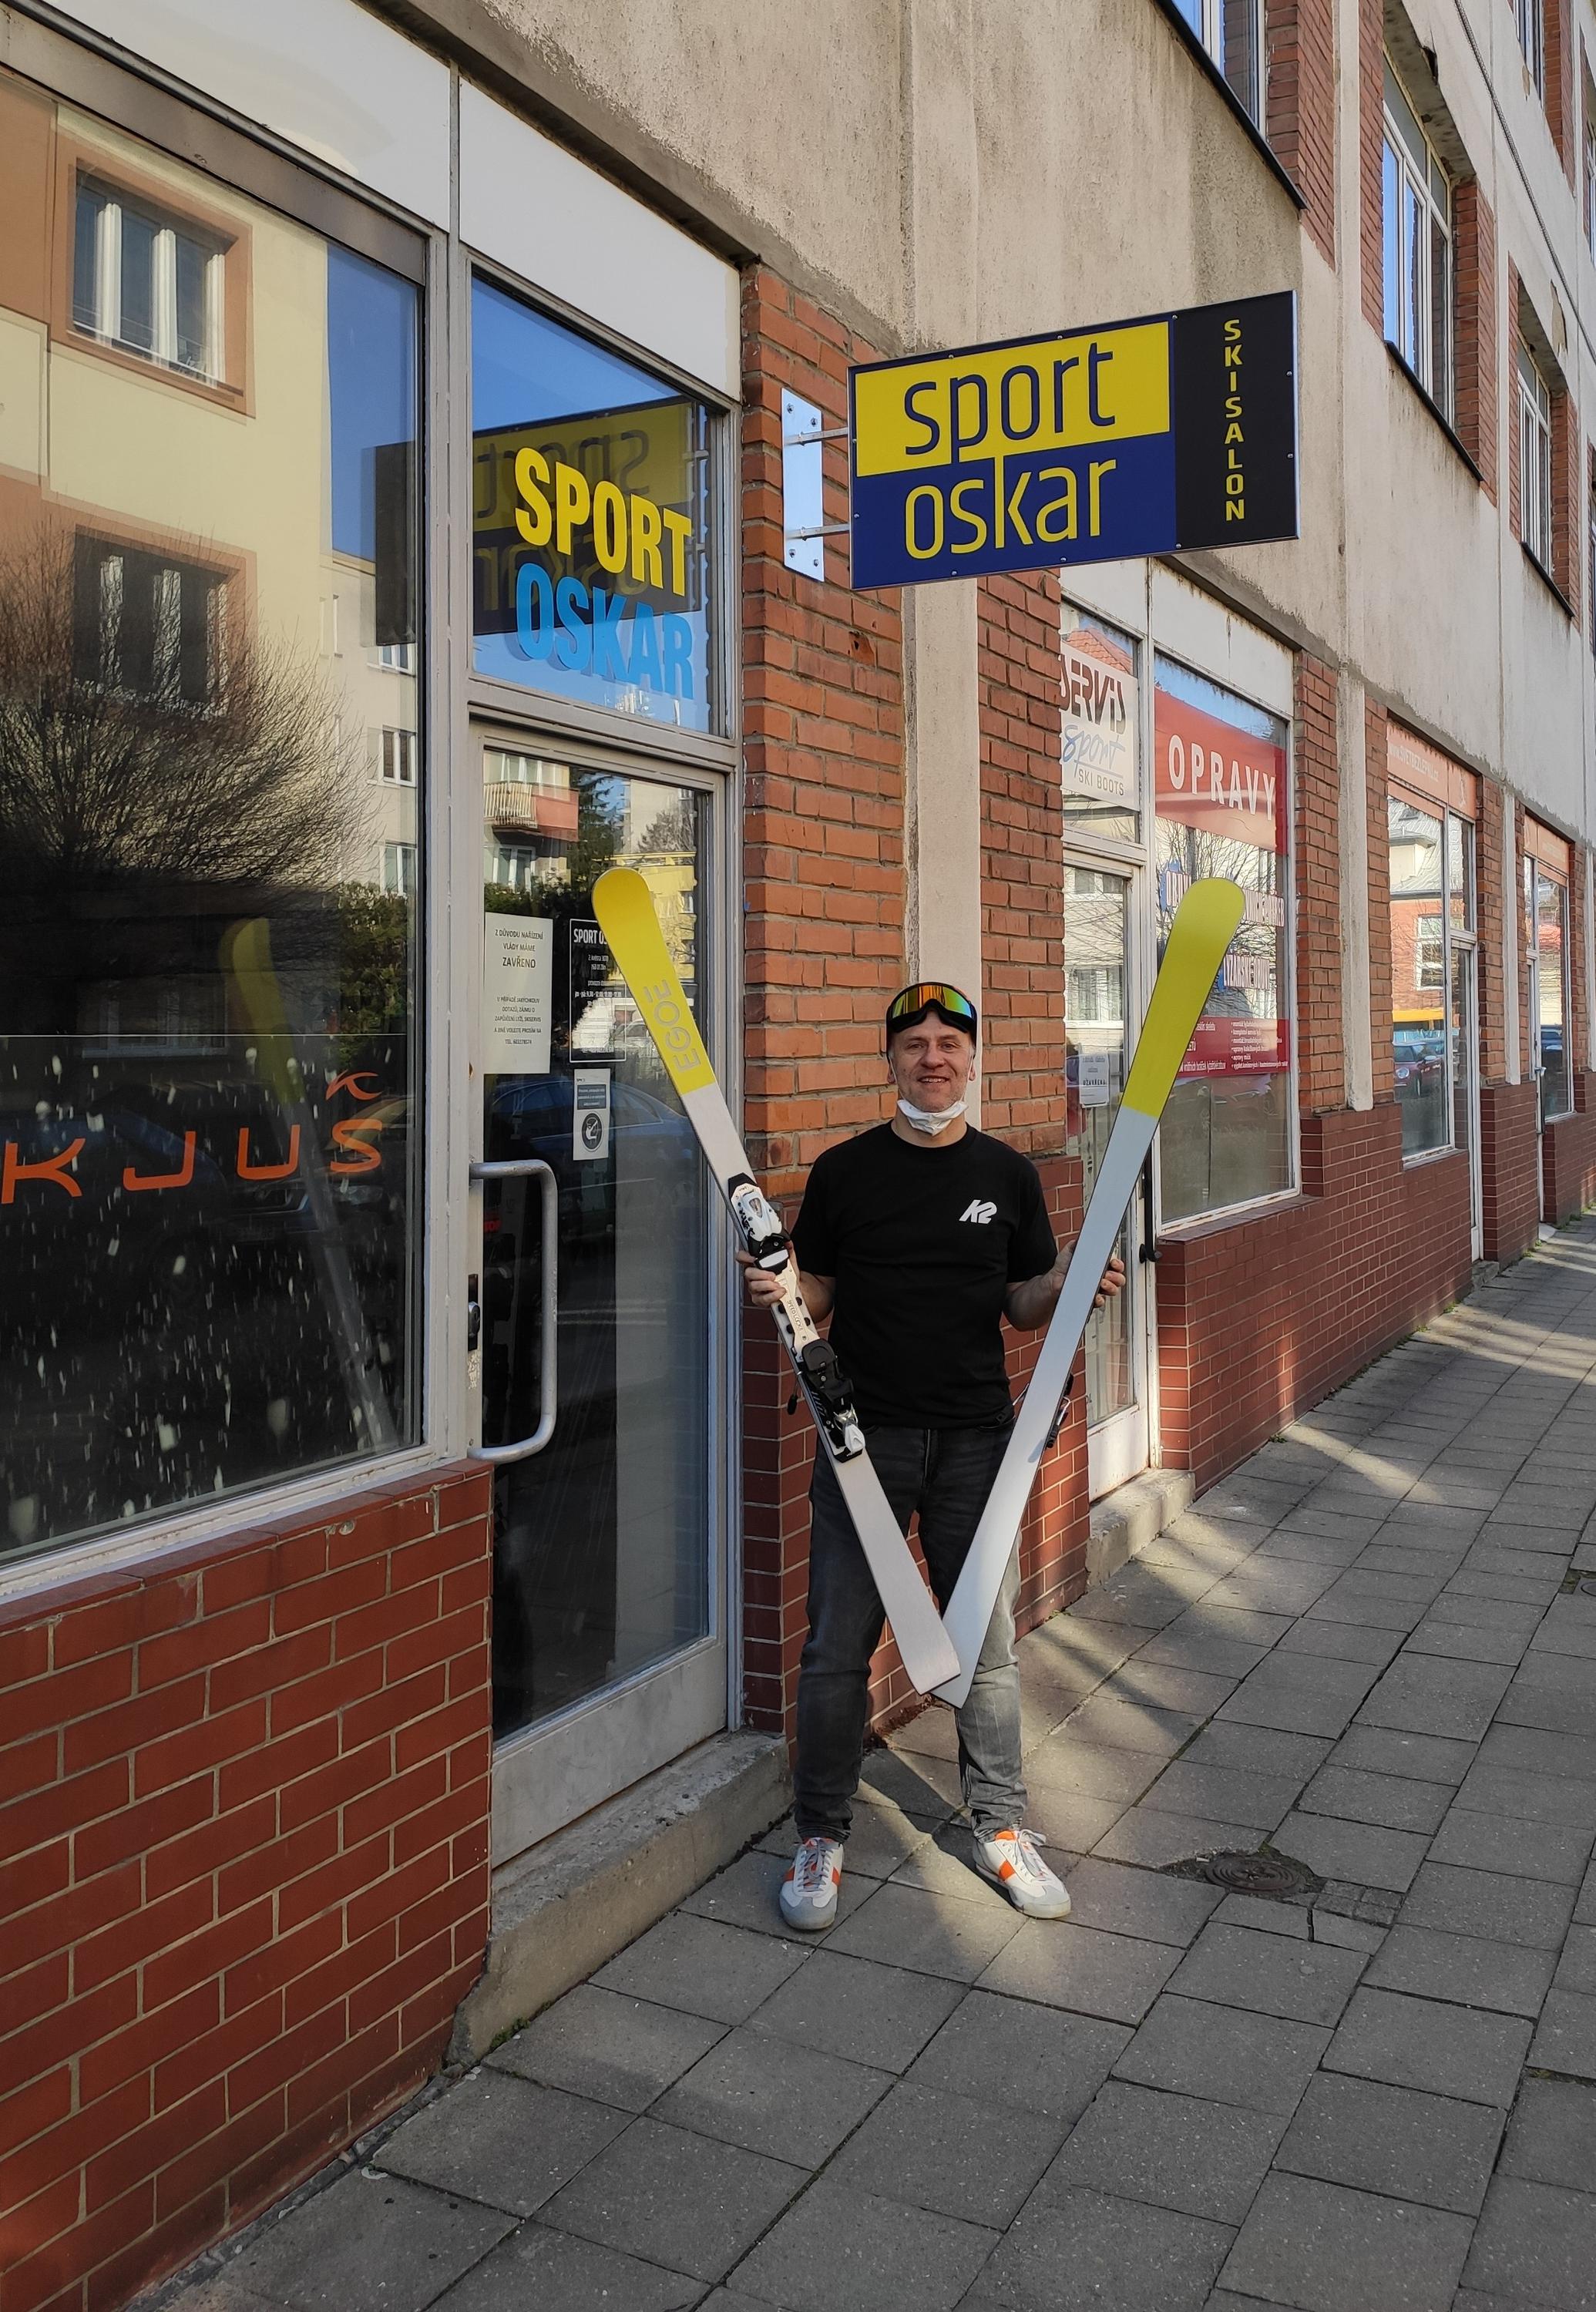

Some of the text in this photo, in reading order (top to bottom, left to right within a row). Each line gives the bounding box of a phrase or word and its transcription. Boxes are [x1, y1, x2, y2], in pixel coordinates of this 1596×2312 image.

[904, 342, 1115, 462] sport
[1224, 318, 1246, 522] SKISALON
[515, 447, 692, 596] SPORT
[905, 456, 1117, 560] oskar
[516, 562, 694, 700] OSKAR
[1079, 768, 1124, 796] SKI BOOTS
[1168, 734, 1276, 822] OPRAVY
[499, 928, 520, 938] DŮVODU
[502, 956, 536, 969] ZAVŘENO
[503, 942, 536, 952] VLÁDY MÁME
[573, 928, 598, 944] SPORT
[1, 1118, 384, 1205] KJUS
[959, 1199, 997, 1225] K2
